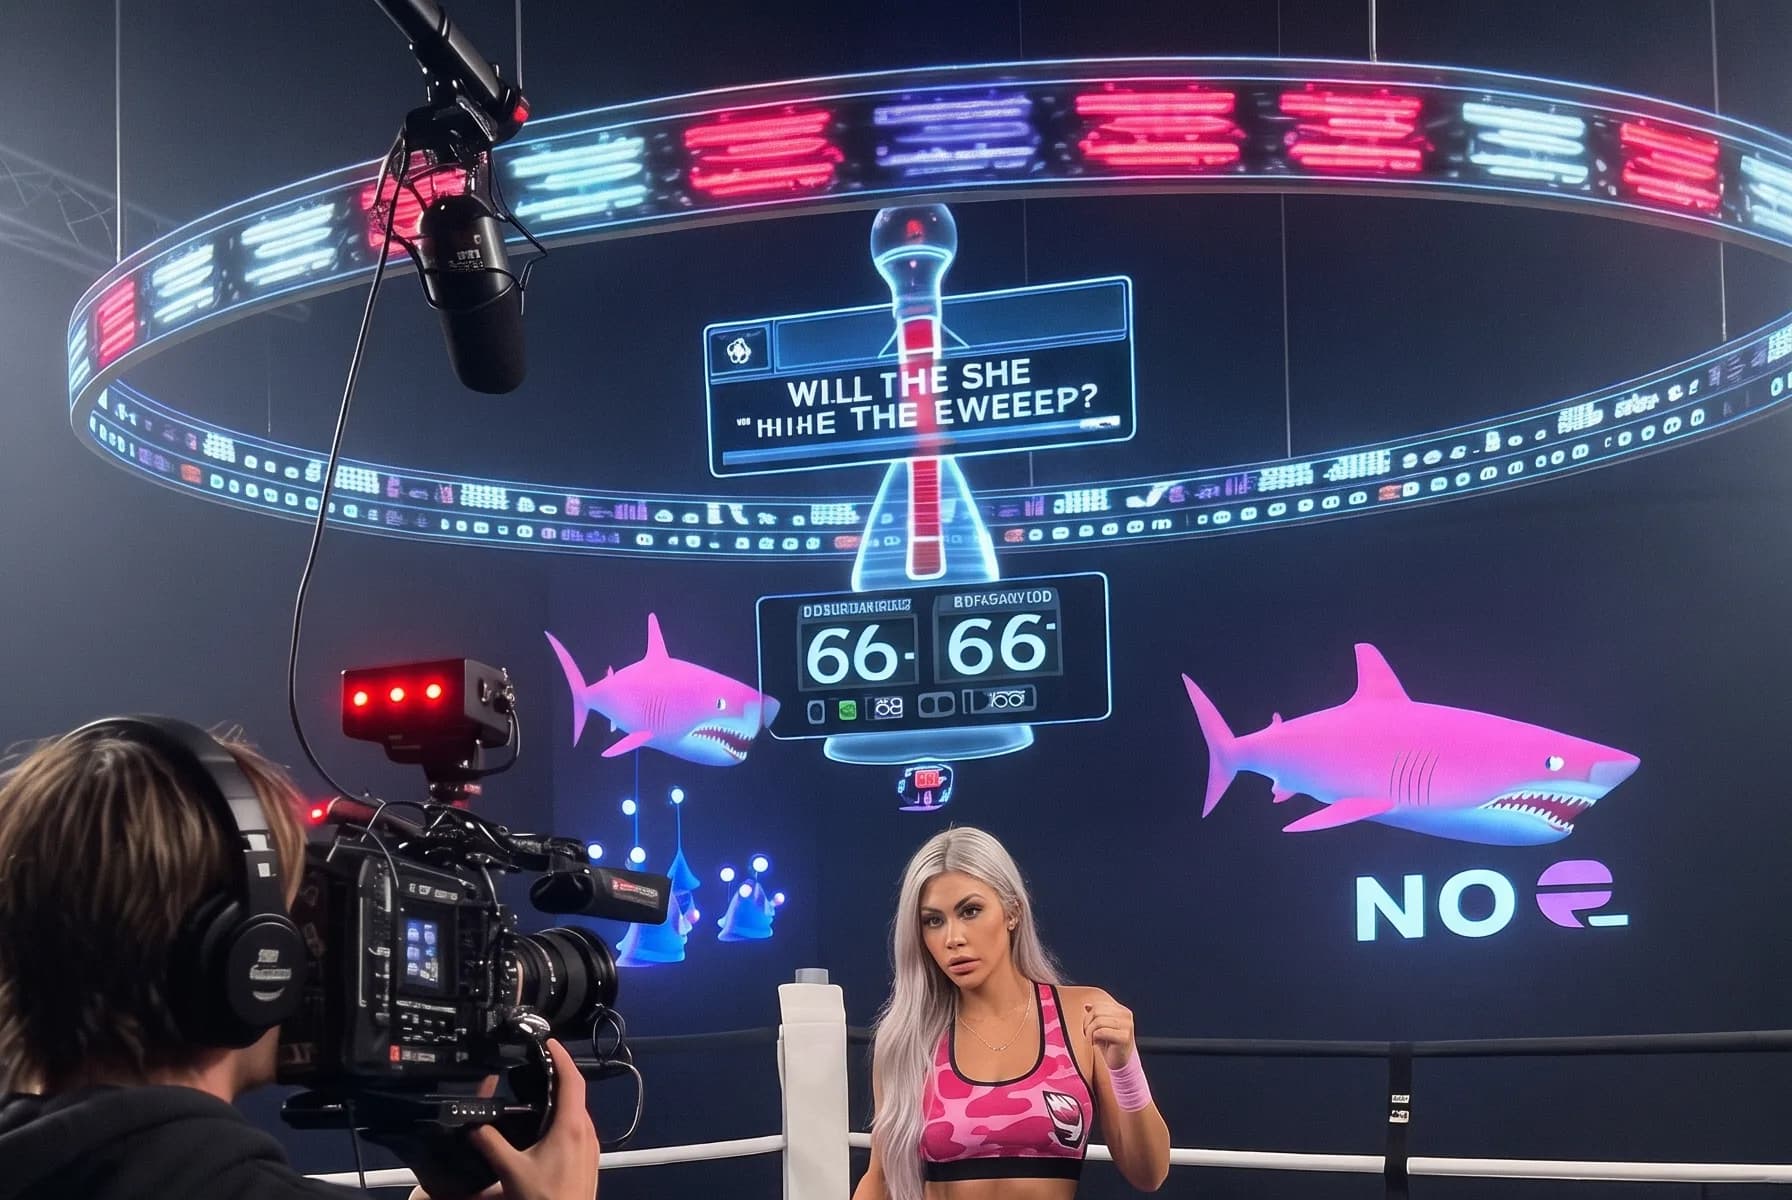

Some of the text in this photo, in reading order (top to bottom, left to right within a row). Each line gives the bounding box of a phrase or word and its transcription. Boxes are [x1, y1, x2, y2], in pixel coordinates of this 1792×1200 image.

[880, 366, 949, 398] THE
[961, 358, 1031, 389] SHE
[850, 402, 918, 431] THE
[1356, 868, 1516, 942] NO
